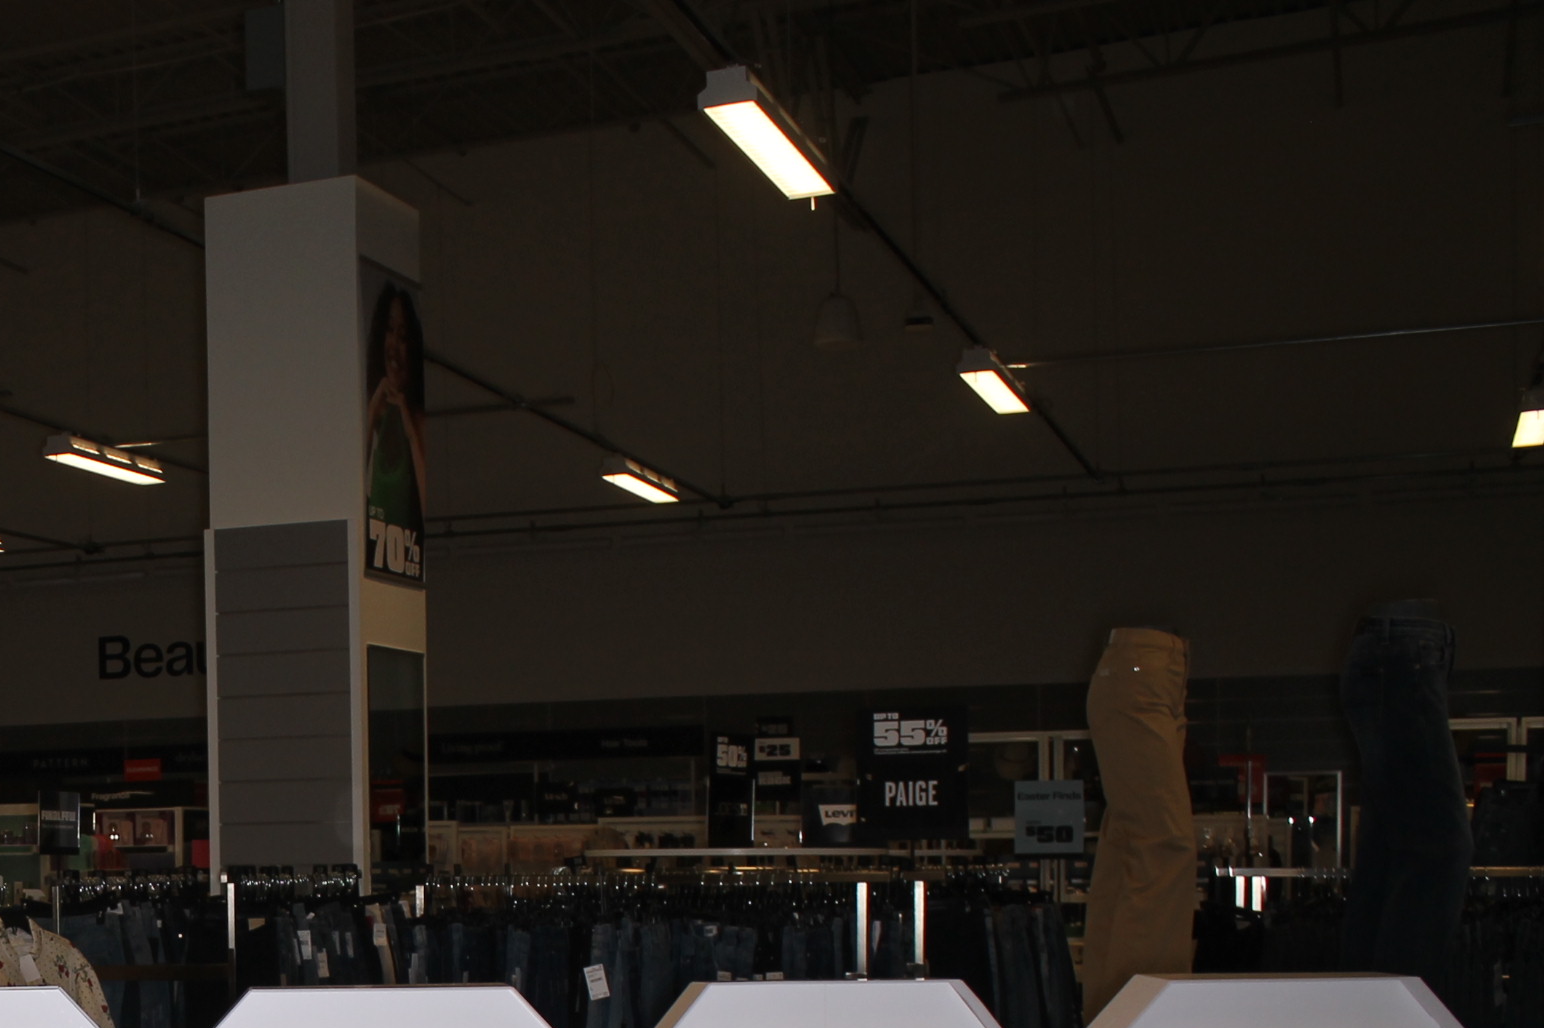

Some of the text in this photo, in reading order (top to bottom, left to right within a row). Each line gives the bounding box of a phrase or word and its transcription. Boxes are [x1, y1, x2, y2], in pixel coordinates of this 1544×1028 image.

[369, 518, 421, 574] 70%
[873, 719, 948, 747] 55%
[884, 780, 939, 807] PAIGE
[1025, 825, 1074, 843] $50
